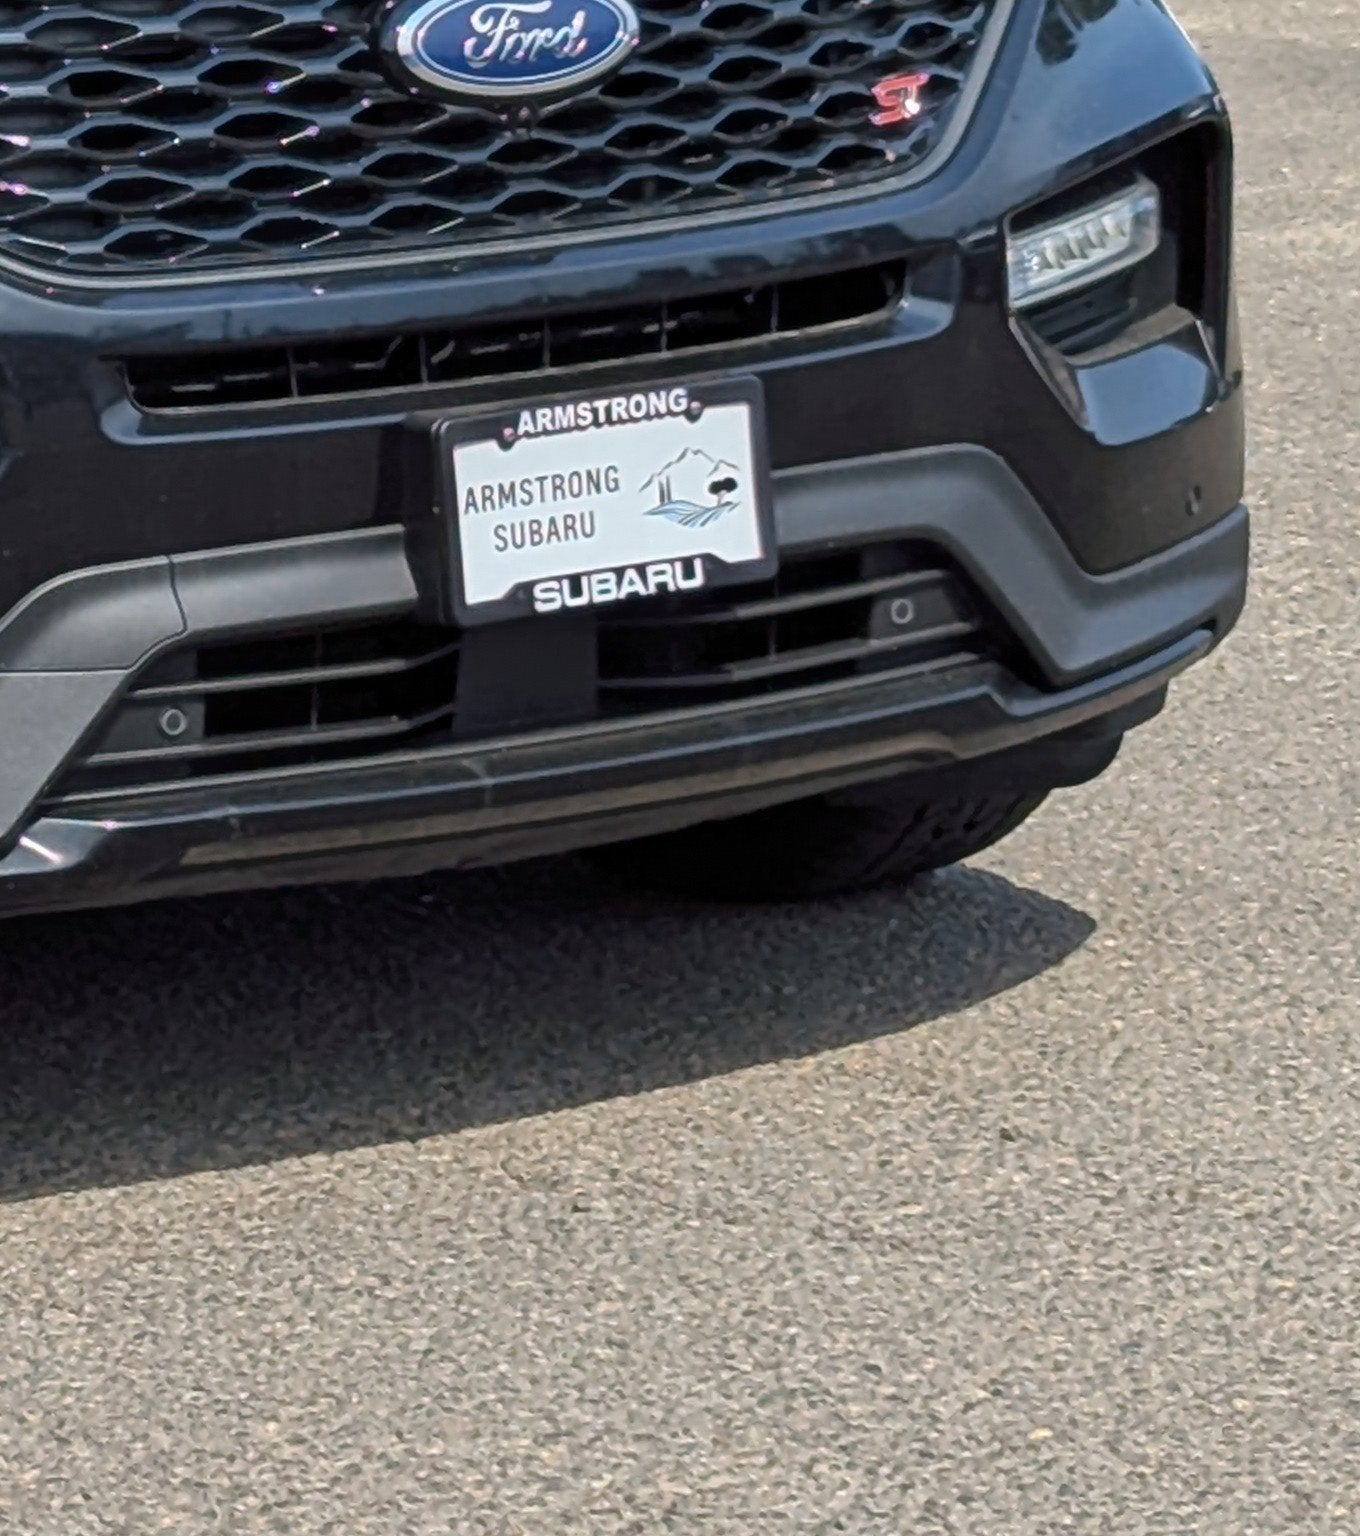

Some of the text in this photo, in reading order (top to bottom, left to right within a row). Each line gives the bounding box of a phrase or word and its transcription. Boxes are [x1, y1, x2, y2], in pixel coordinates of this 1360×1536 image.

[464, 0, 588, 66] Ford
[516, 388, 691, 437] ARMSTRONG
[463, 465, 621, 515] ARMSTRONG
[493, 510, 596, 553] SUBARU
[532, 558, 705, 613] SUBARU
